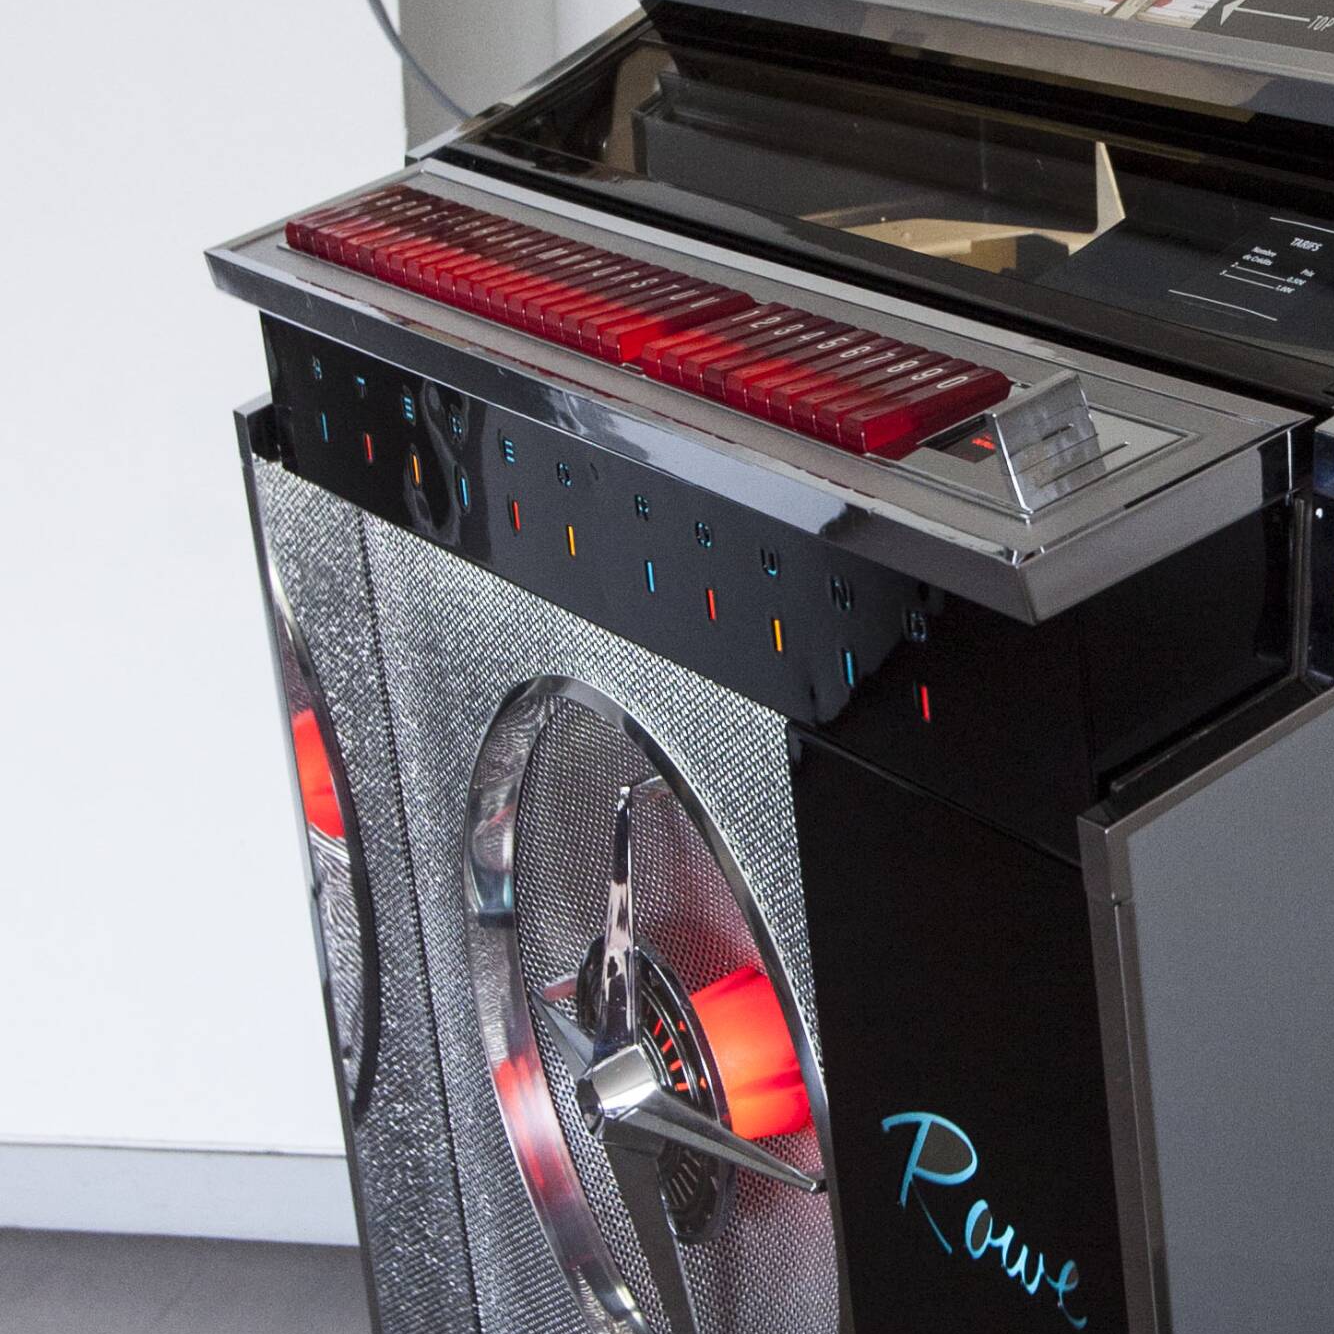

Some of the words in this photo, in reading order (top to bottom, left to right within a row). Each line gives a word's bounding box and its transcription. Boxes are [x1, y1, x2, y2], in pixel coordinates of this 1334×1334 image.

[1289, 236, 1323, 252] TARIFS
[629, 278, 659, 289] S
[650, 284, 680, 295] T
[669, 289, 700, 301] U
[689, 297, 721, 308] V
[731, 310, 760, 322] 1
[750, 316, 782, 329] 2
[773, 323, 805, 336] 3
[798, 330, 826, 343] 4
[816, 337, 849, 350] 5
[839, 345, 872, 359] 6
[863, 352, 895, 364] 7
[886, 359, 919, 373] 8
[911, 367, 943, 381] 9
[936, 375, 969, 389] 0
[880, 1110, 1088, 1330] Rowe
